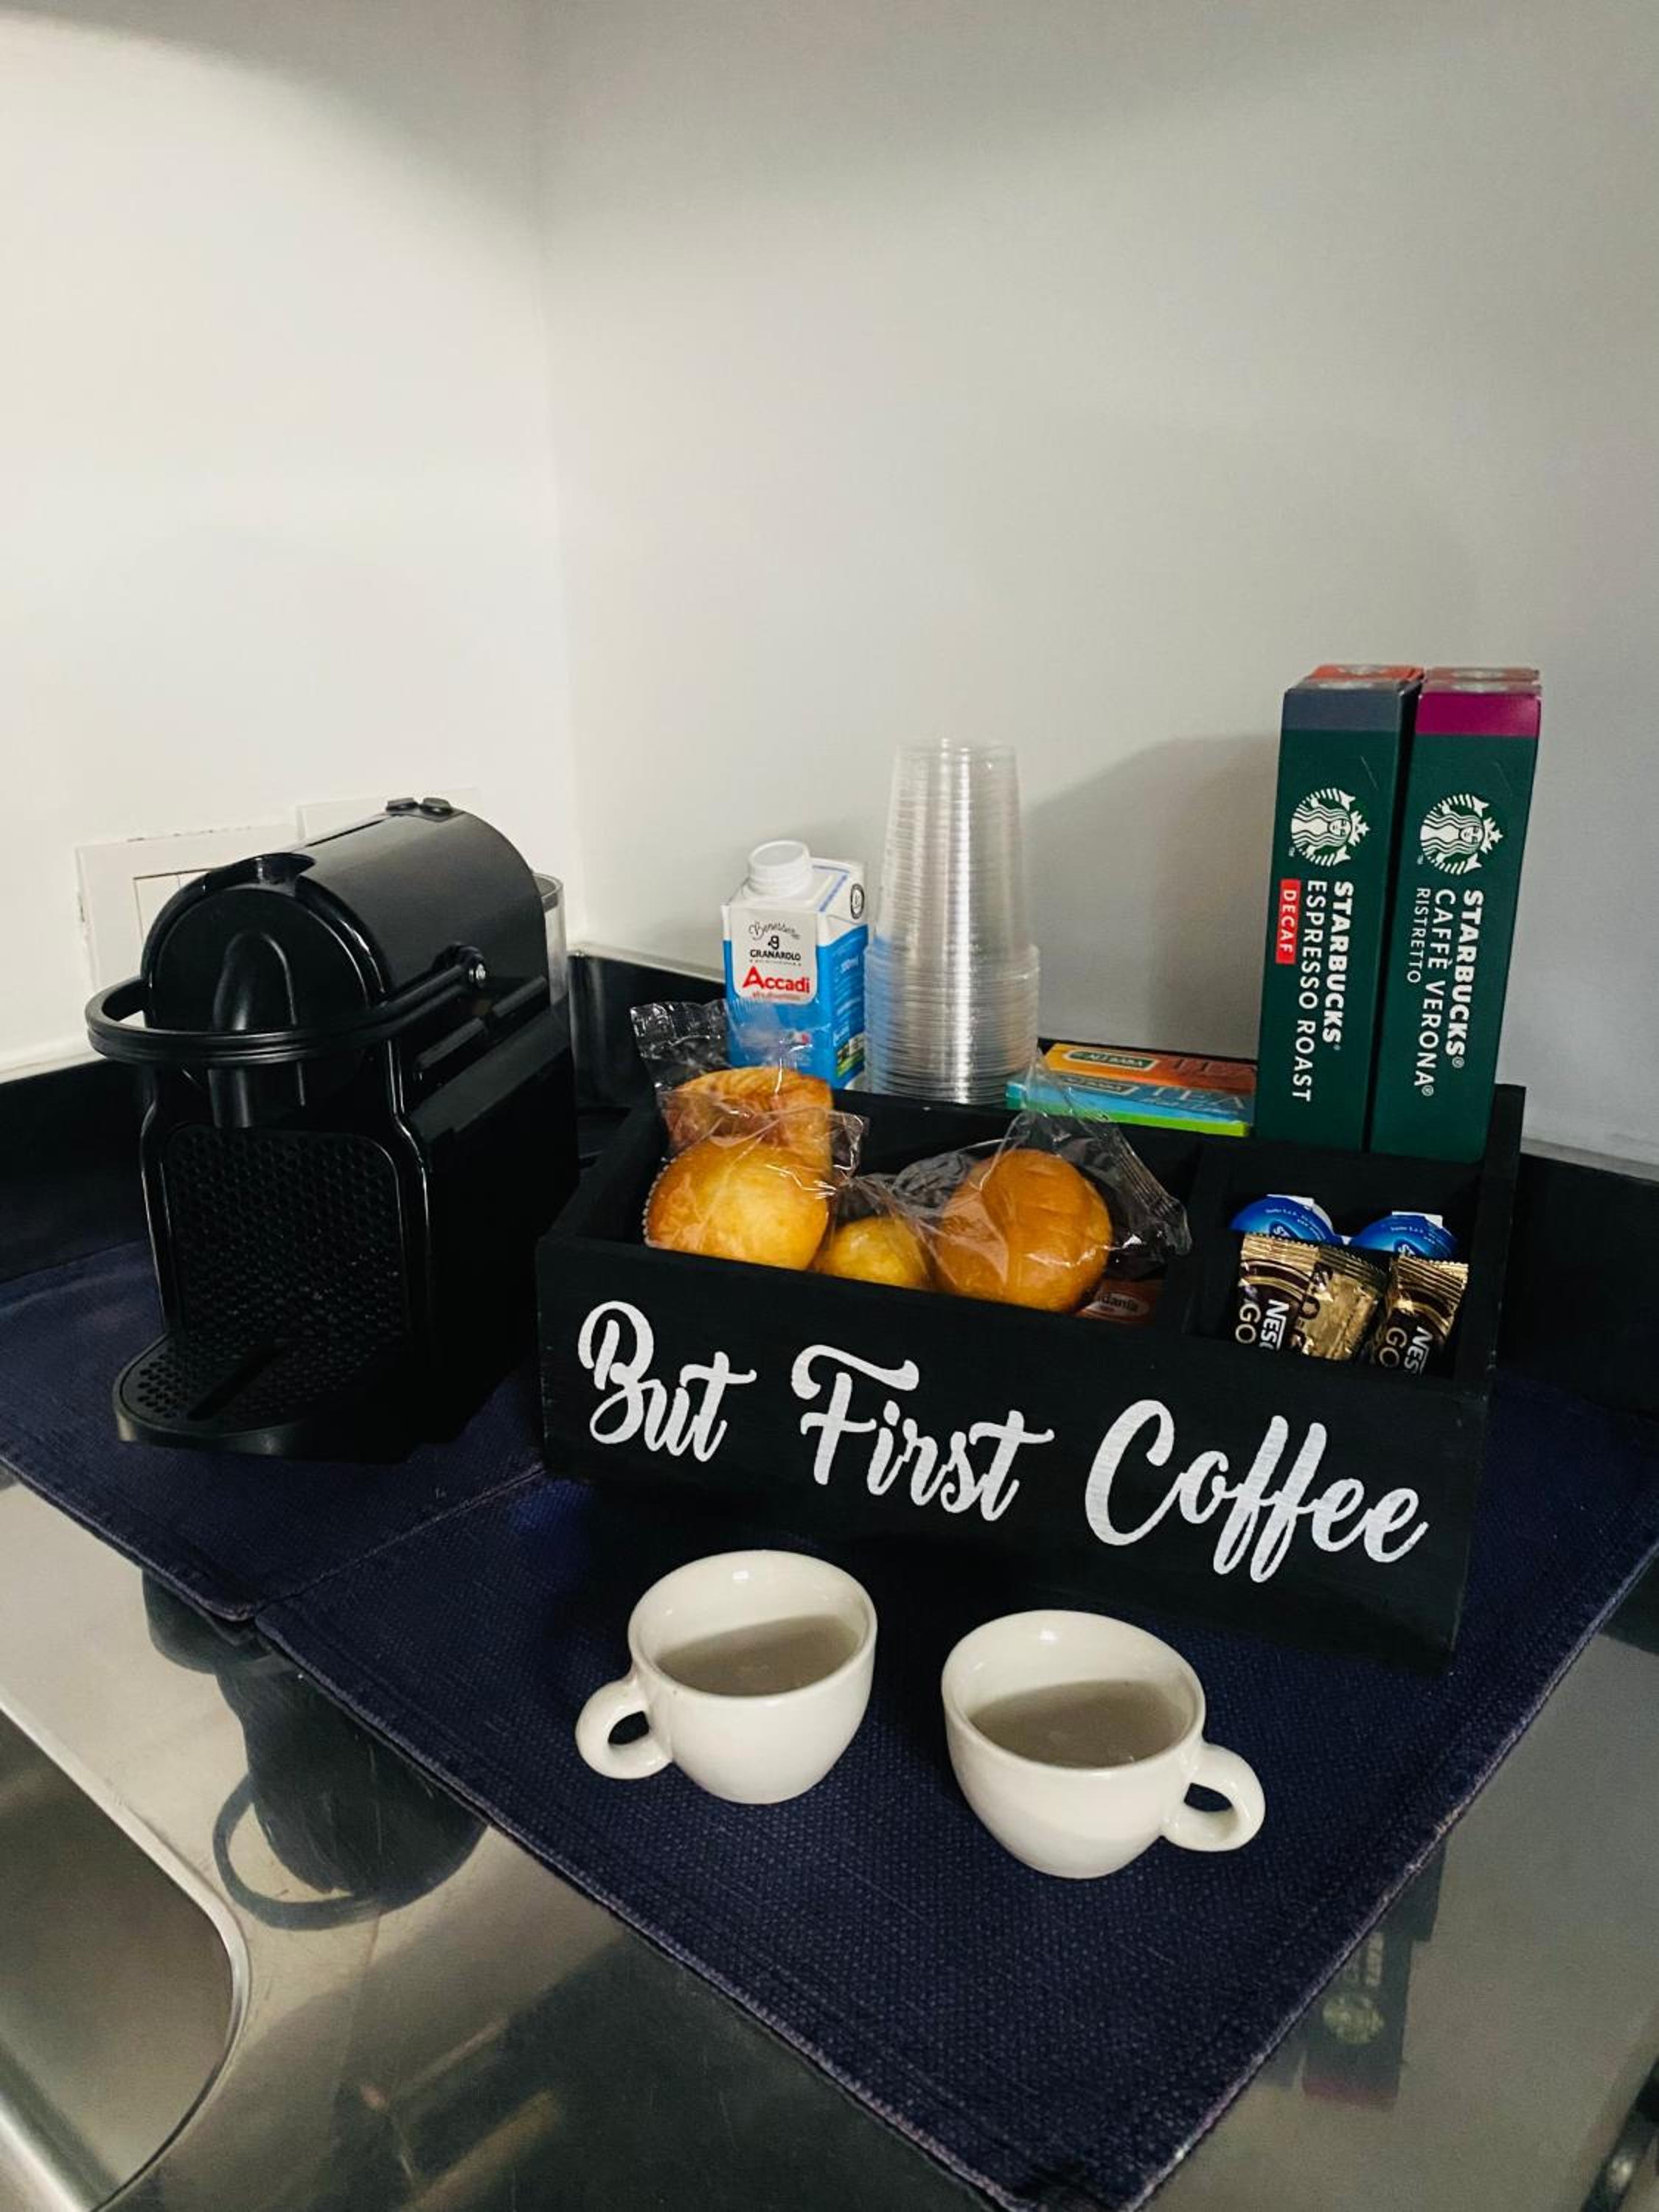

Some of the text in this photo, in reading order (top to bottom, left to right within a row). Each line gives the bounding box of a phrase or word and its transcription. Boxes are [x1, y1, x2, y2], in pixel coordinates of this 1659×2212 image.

[742, 966, 810, 993] Accadi
[1279, 889, 1298, 953] DECAF
[1321, 881, 1354, 1043] STARBUCKS
[1407, 888, 1431, 983] RISTRETTO
[1292, 880, 1328, 1102] ESPRESSO ROAST
[577, 1300, 1429, 1583] But First Coffee
